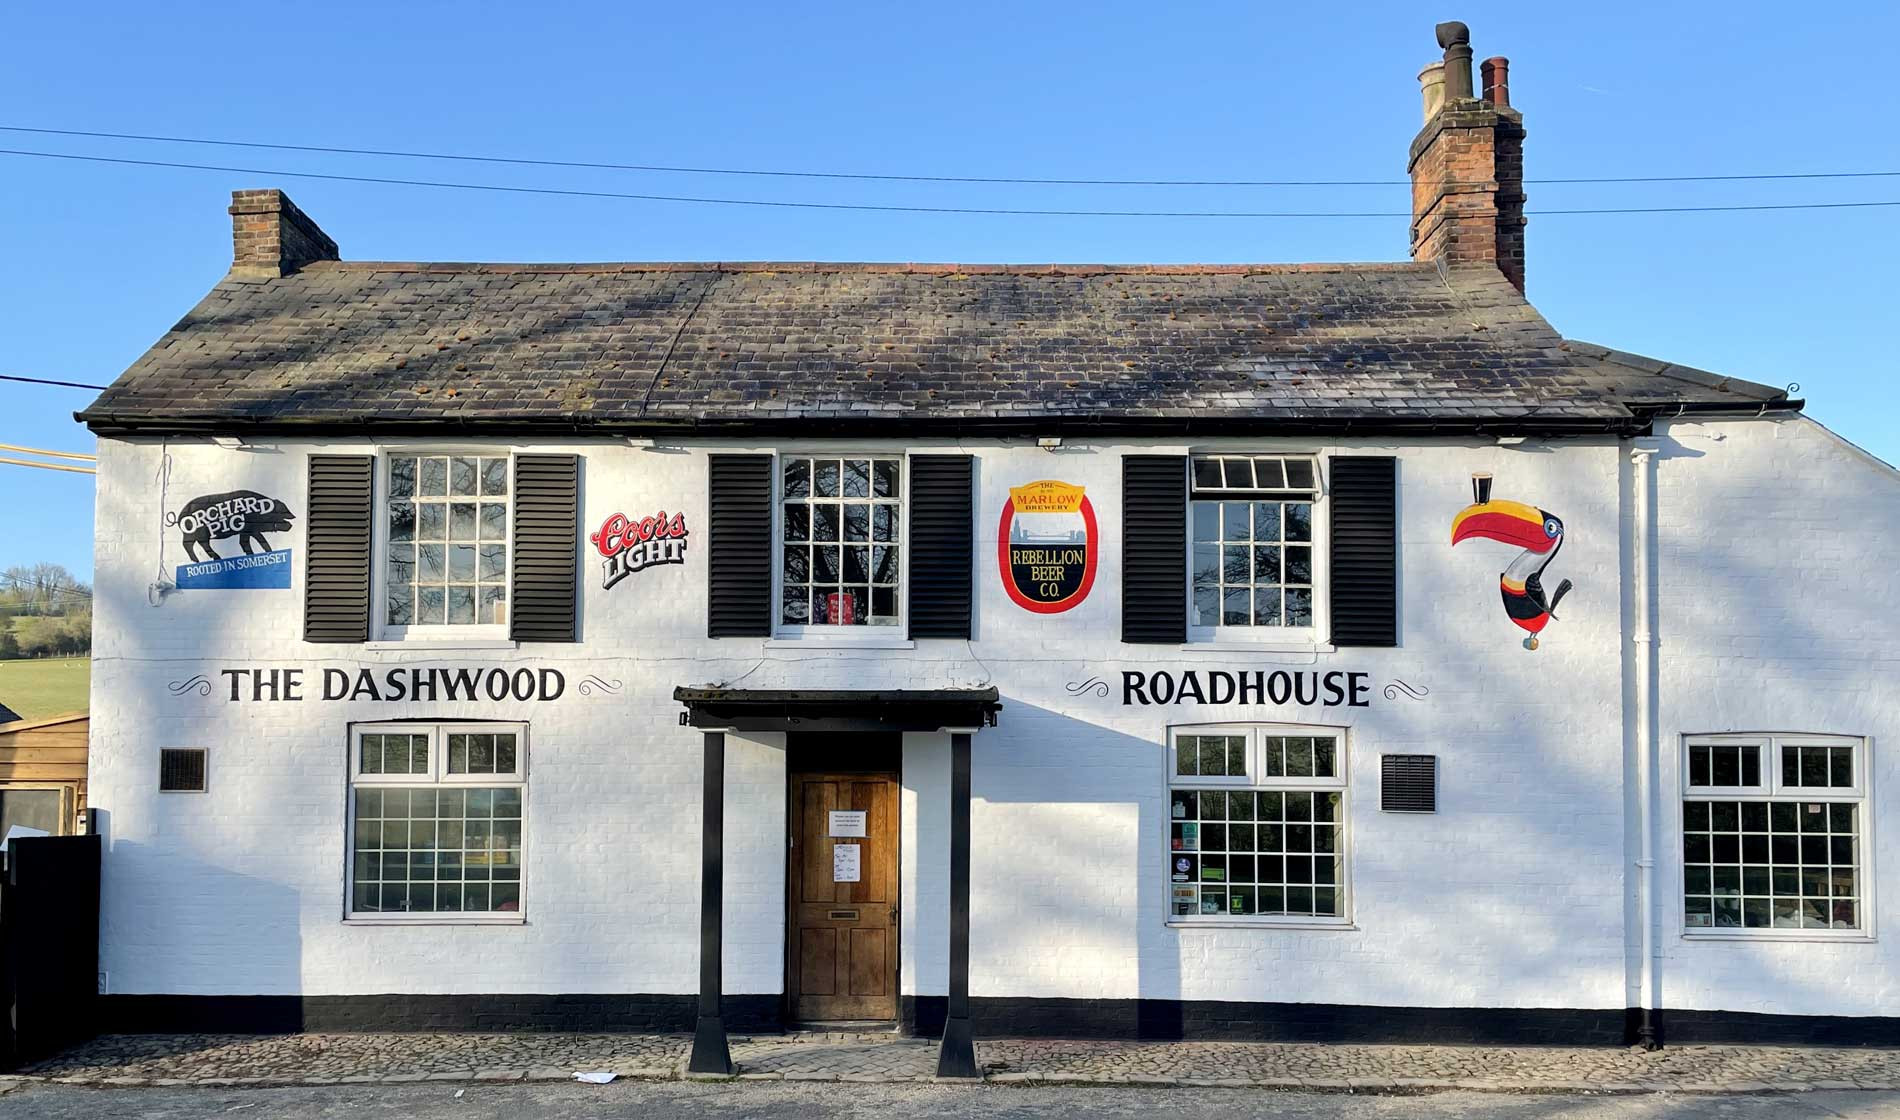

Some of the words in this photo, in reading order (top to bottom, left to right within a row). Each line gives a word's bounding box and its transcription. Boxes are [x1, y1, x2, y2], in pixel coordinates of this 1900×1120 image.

[1017, 495, 1077, 504] MARLOW
[180, 497, 275, 534] ORCHARD
[207, 514, 245, 538] PIG
[590, 511, 690, 557] Coors
[186, 561, 222, 577] ROOTED
[224, 559, 236, 571] IN
[236, 552, 288, 570] SOMERSET
[602, 538, 687, 590] LIGHT
[1012, 550, 1083, 565] REBELLION
[1031, 566, 1065, 581] BEER
[221, 668, 304, 701] THE
[322, 668, 566, 702] DASHWOOD
[1121, 670, 1371, 707] ROADHOUSE
